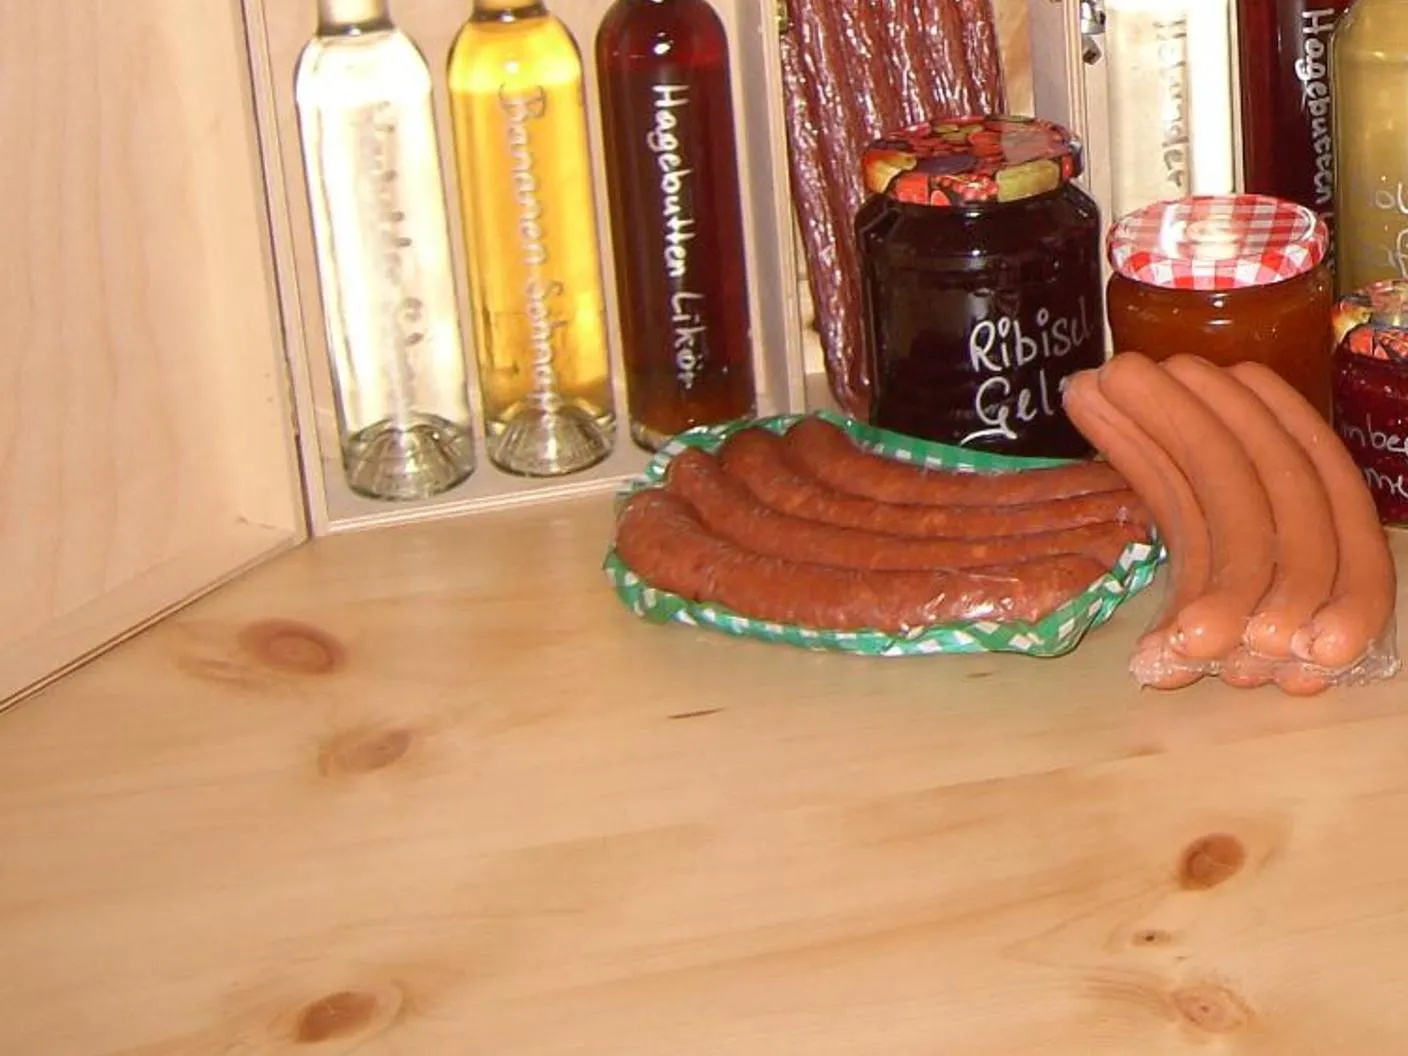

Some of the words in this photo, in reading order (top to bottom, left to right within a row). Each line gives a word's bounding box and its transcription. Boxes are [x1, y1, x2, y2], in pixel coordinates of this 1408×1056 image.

[646, 82, 700, 277] Hagebutten
[669, 294, 706, 389] Likör
[959, 368, 1068, 447] Gel
